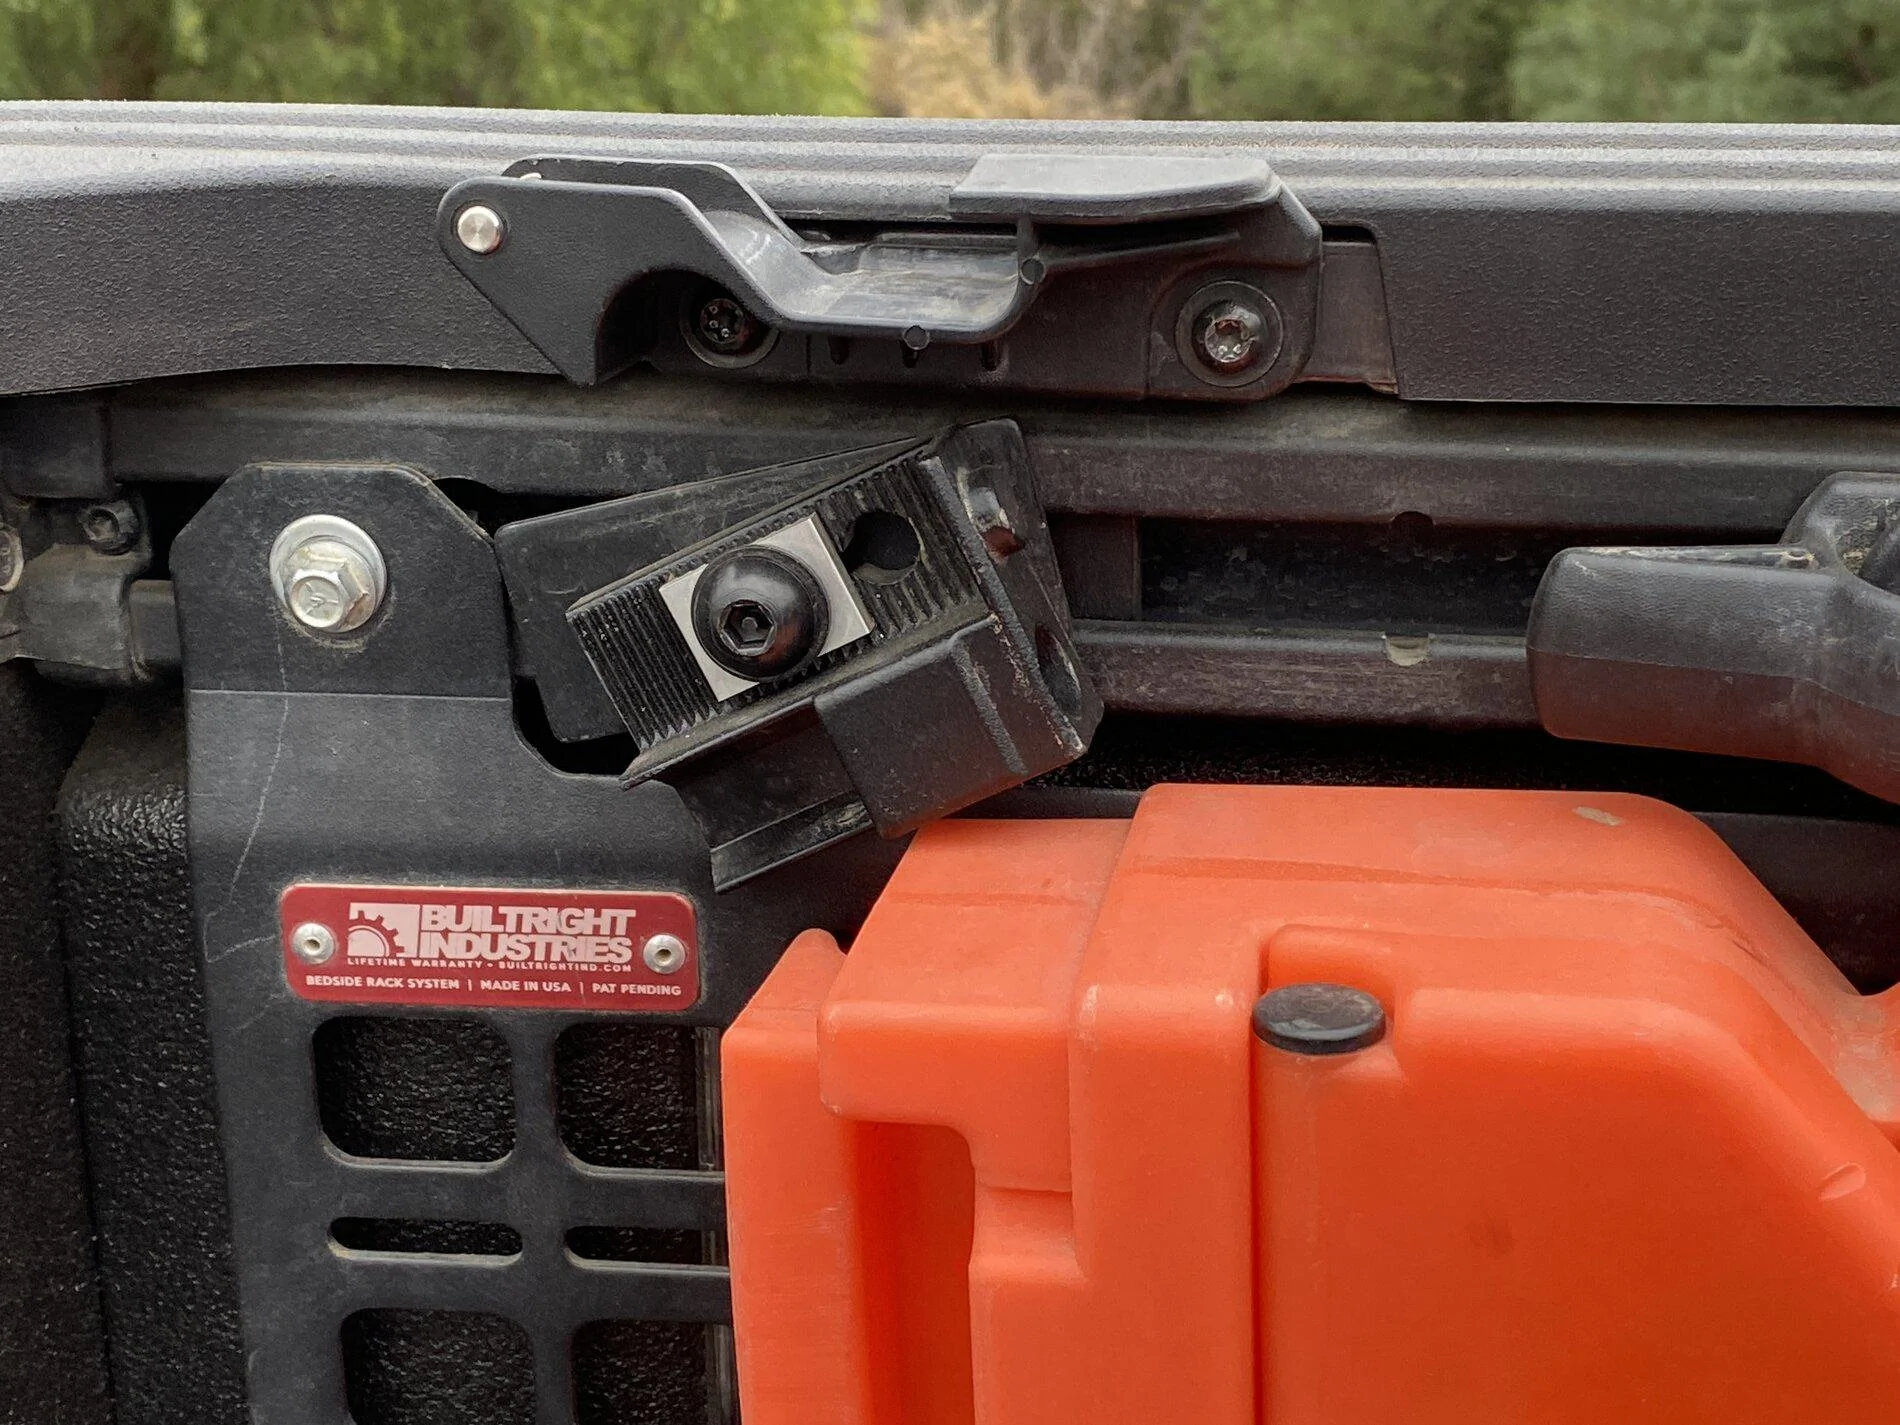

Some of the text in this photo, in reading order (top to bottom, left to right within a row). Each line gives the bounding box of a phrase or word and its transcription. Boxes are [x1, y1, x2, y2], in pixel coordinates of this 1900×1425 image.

[421, 904, 636, 936] BUILTRIGHT
[420, 931, 634, 964] INDUSTRIES
[347, 957, 632, 972] LIFETIME WARRANTY BUILTRIGHTIND.COM
[306, 975, 682, 996] BEDSIDE RACK SYSTEM MADE IN USA PAT PENDING
